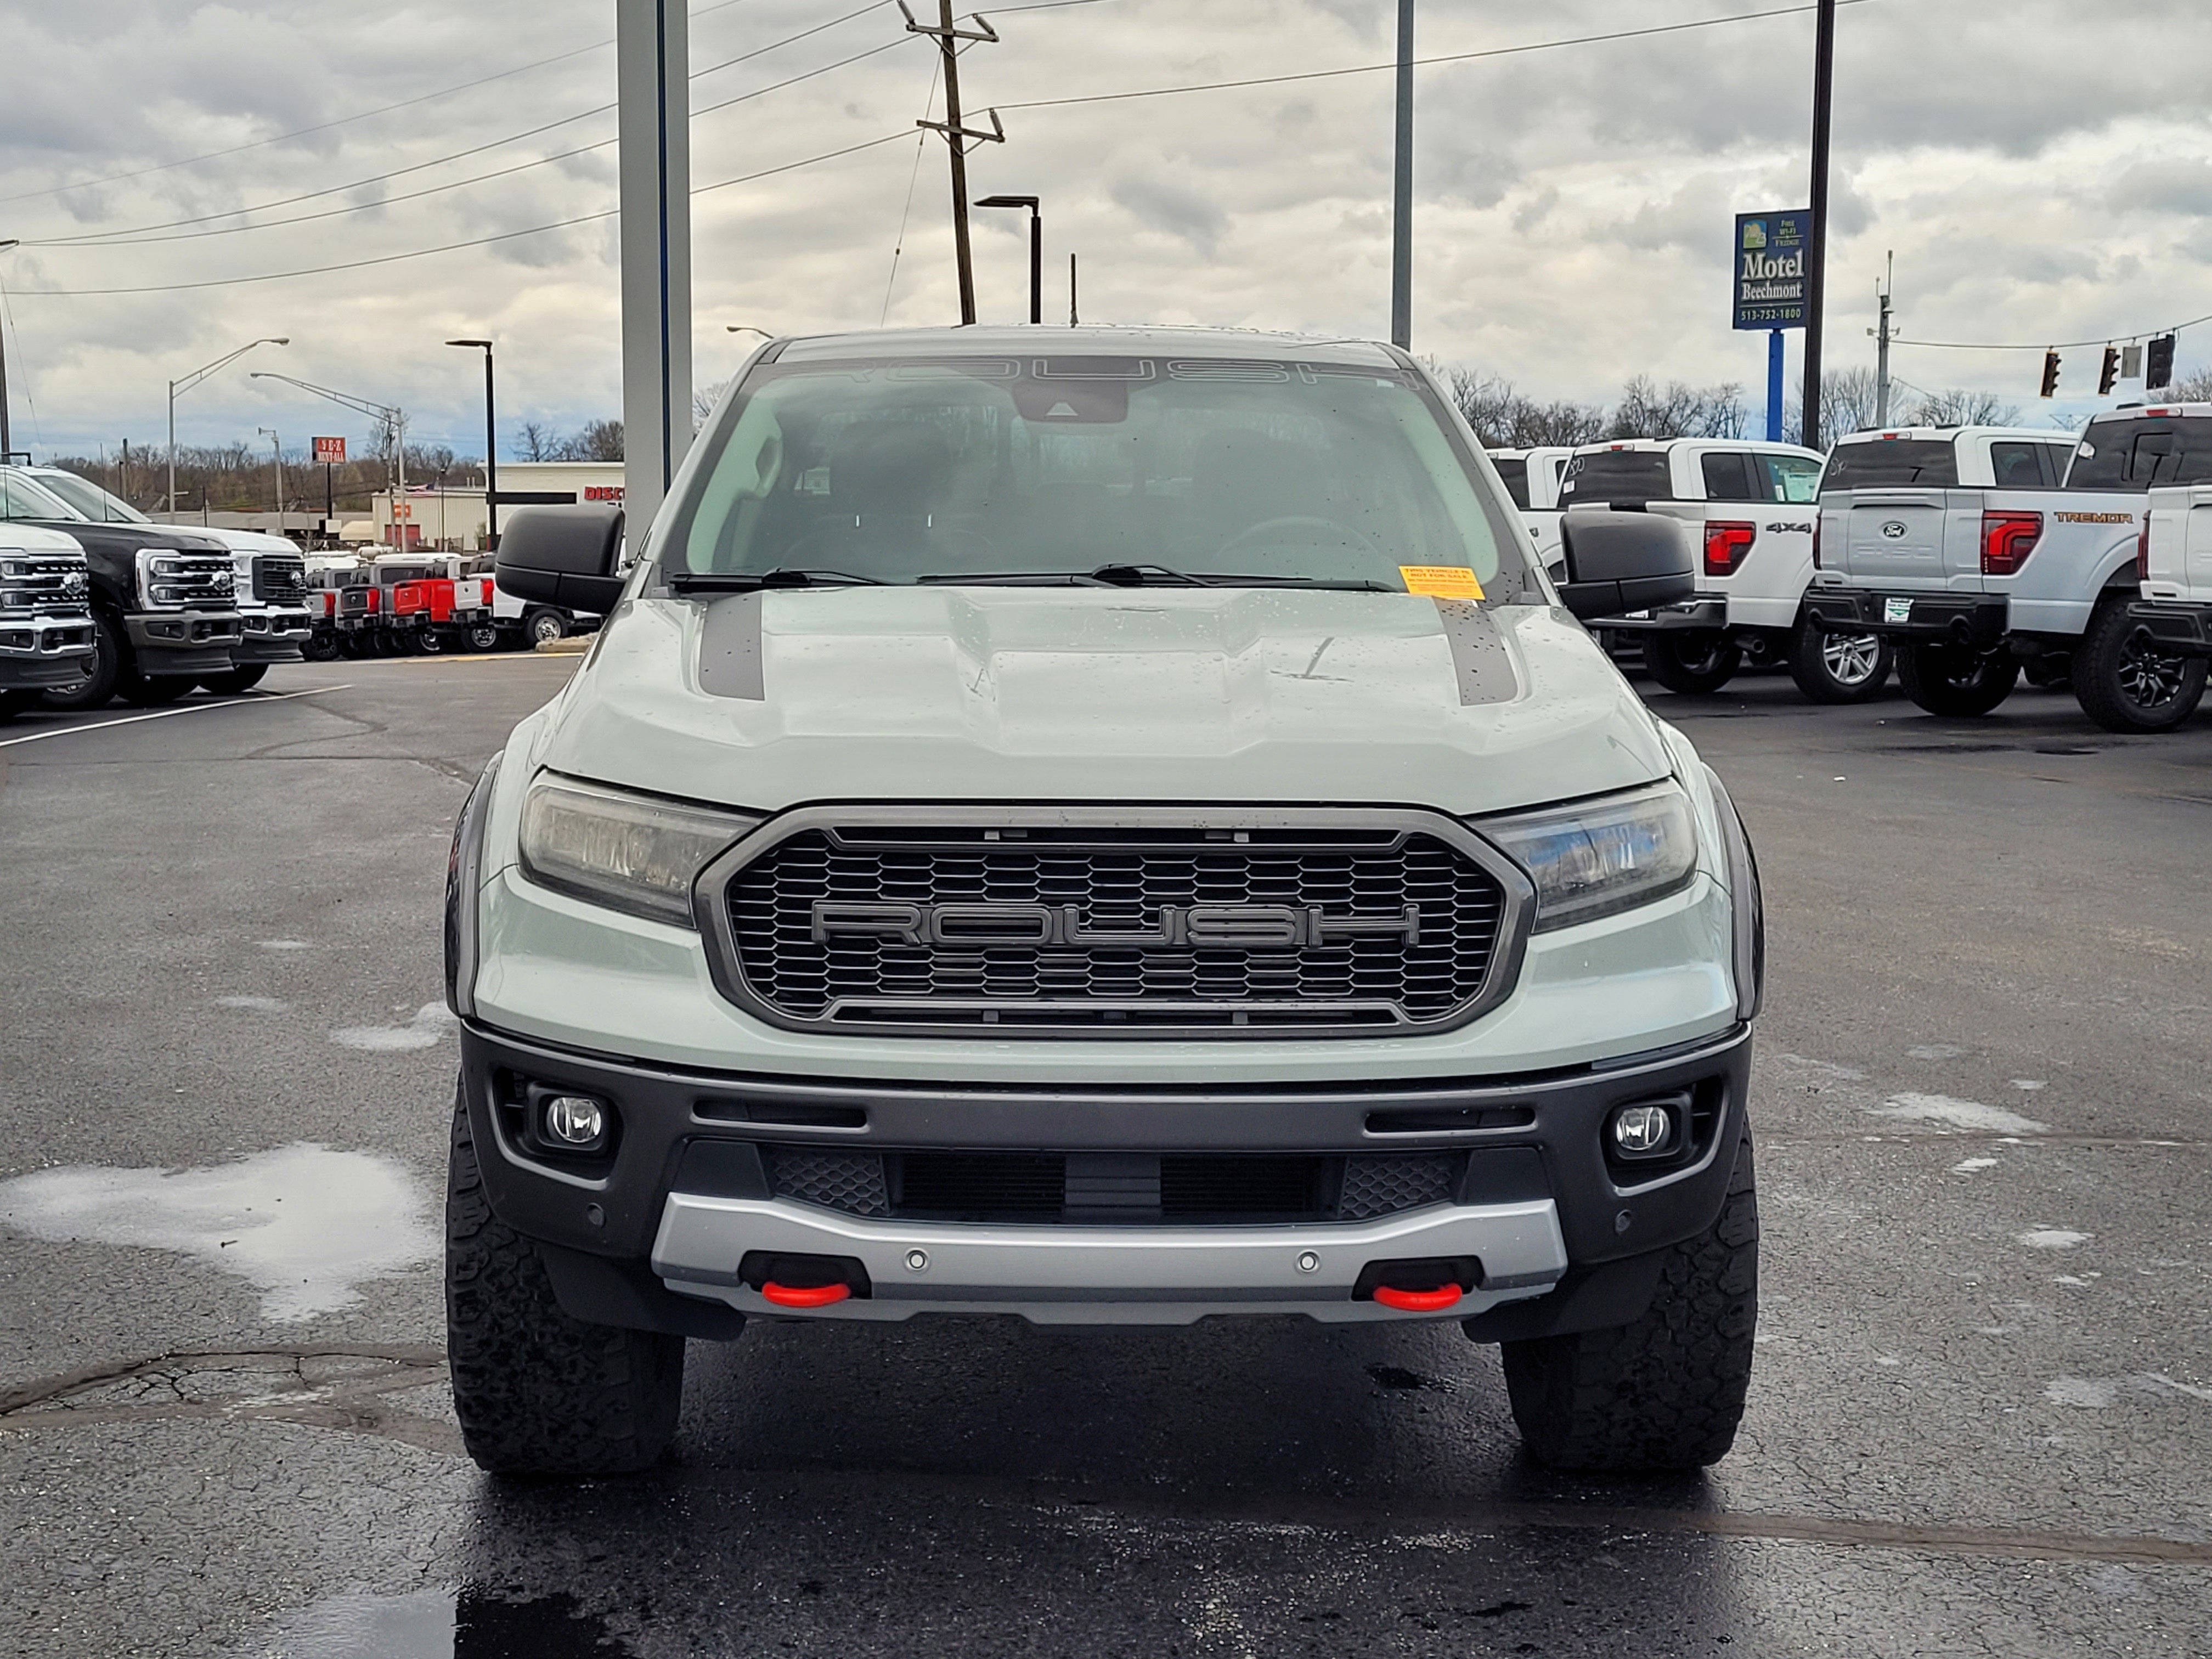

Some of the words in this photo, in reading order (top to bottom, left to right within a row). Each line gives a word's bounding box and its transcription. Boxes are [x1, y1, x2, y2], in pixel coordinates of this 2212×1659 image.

[1741, 248, 1804, 280] Motel
[1741, 280, 1803, 301] Beechmont
[584, 487, 625, 500] DISC
[2053, 511, 2134, 524] TREMOR
[811, 900, 1420, 949] ROUSH
